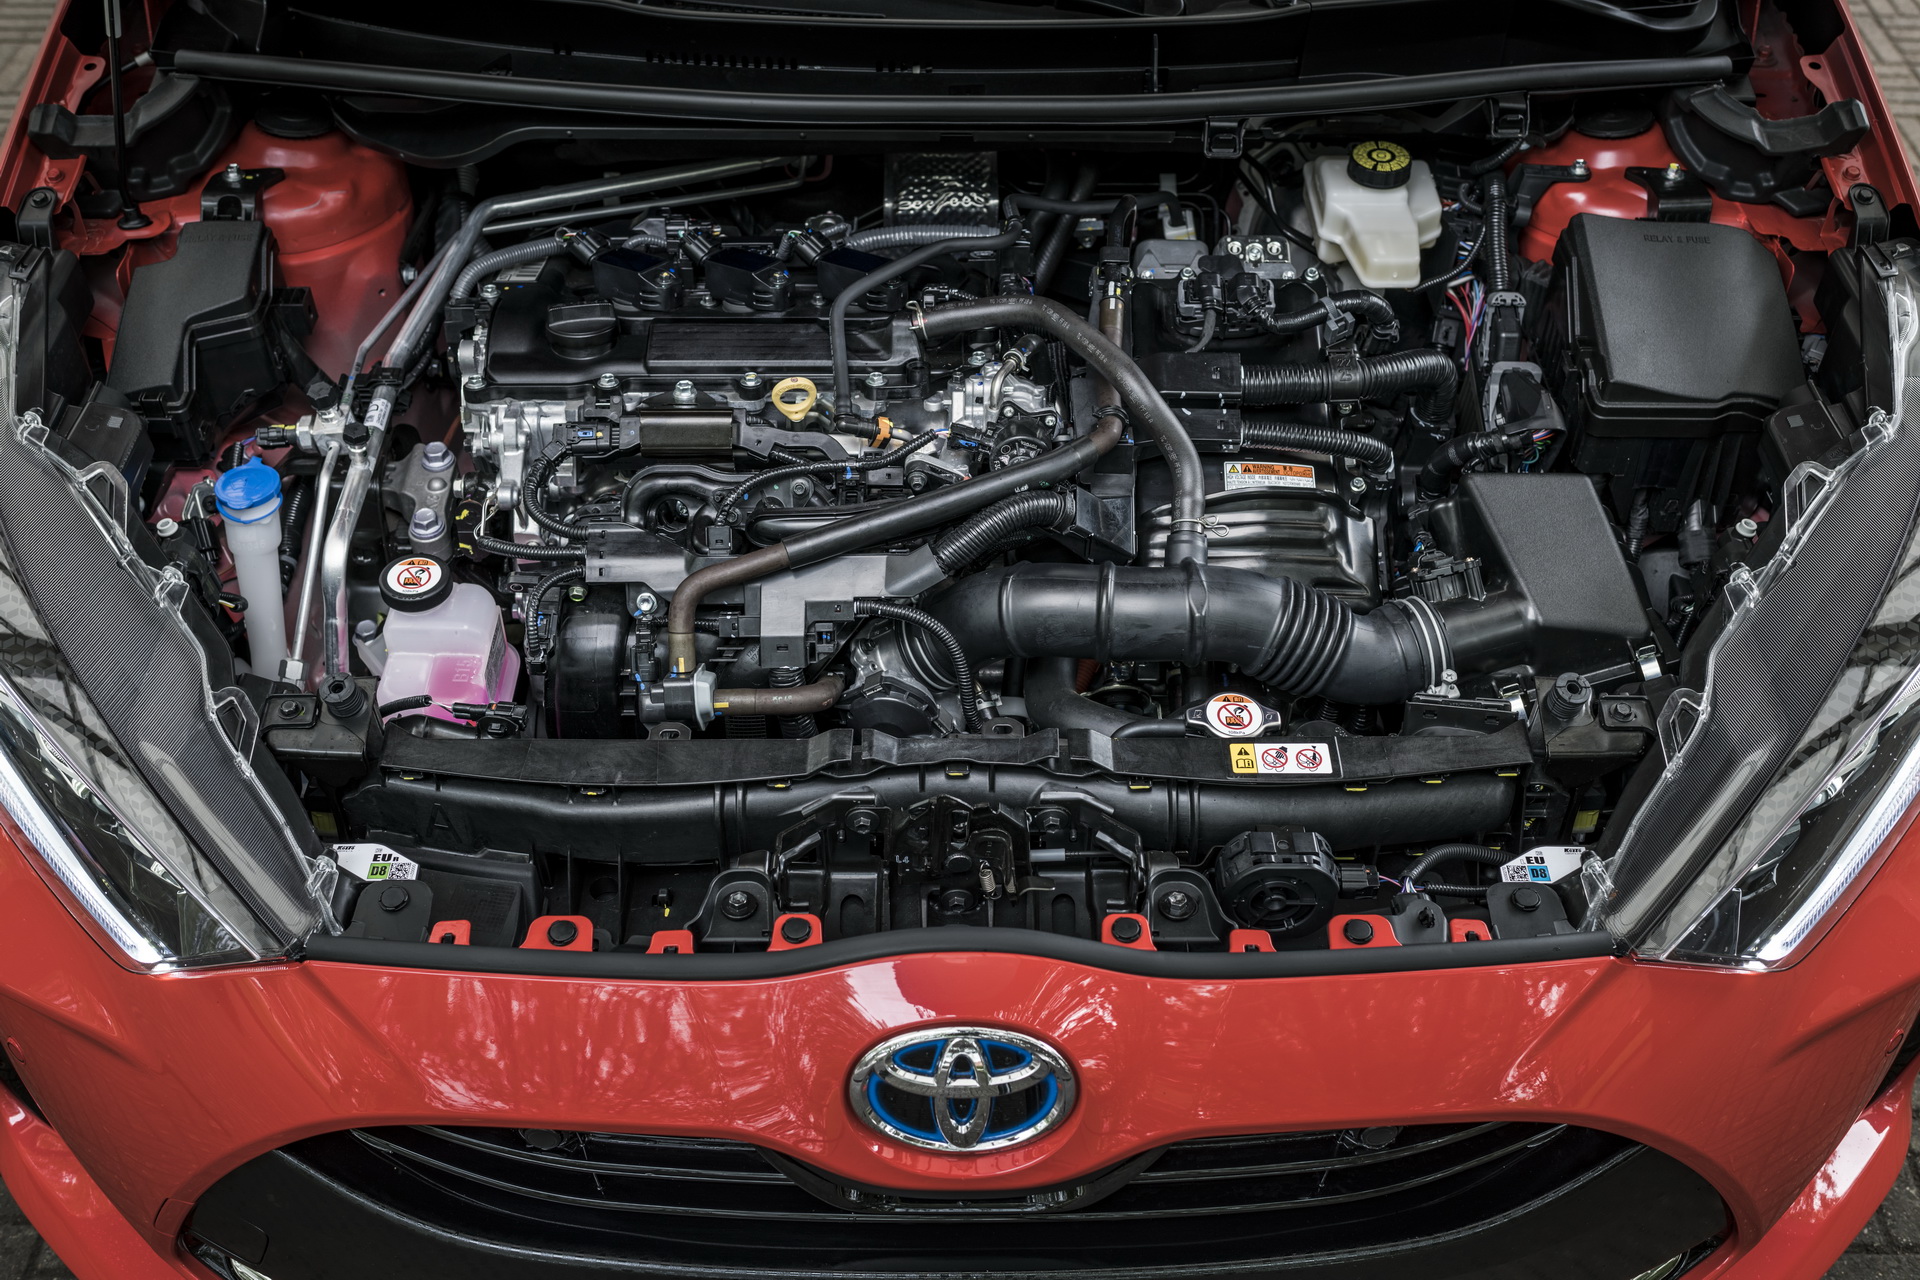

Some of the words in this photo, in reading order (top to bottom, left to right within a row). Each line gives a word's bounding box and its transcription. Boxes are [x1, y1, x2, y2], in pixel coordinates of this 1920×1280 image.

[1643, 234, 1673, 243] RELAY
[1686, 236, 1711, 244] FUSE
[372, 854, 393, 862] EU
[1525, 856, 1545, 864] EU
[371, 866, 387, 876] D8
[1530, 868, 1546, 878] D8
